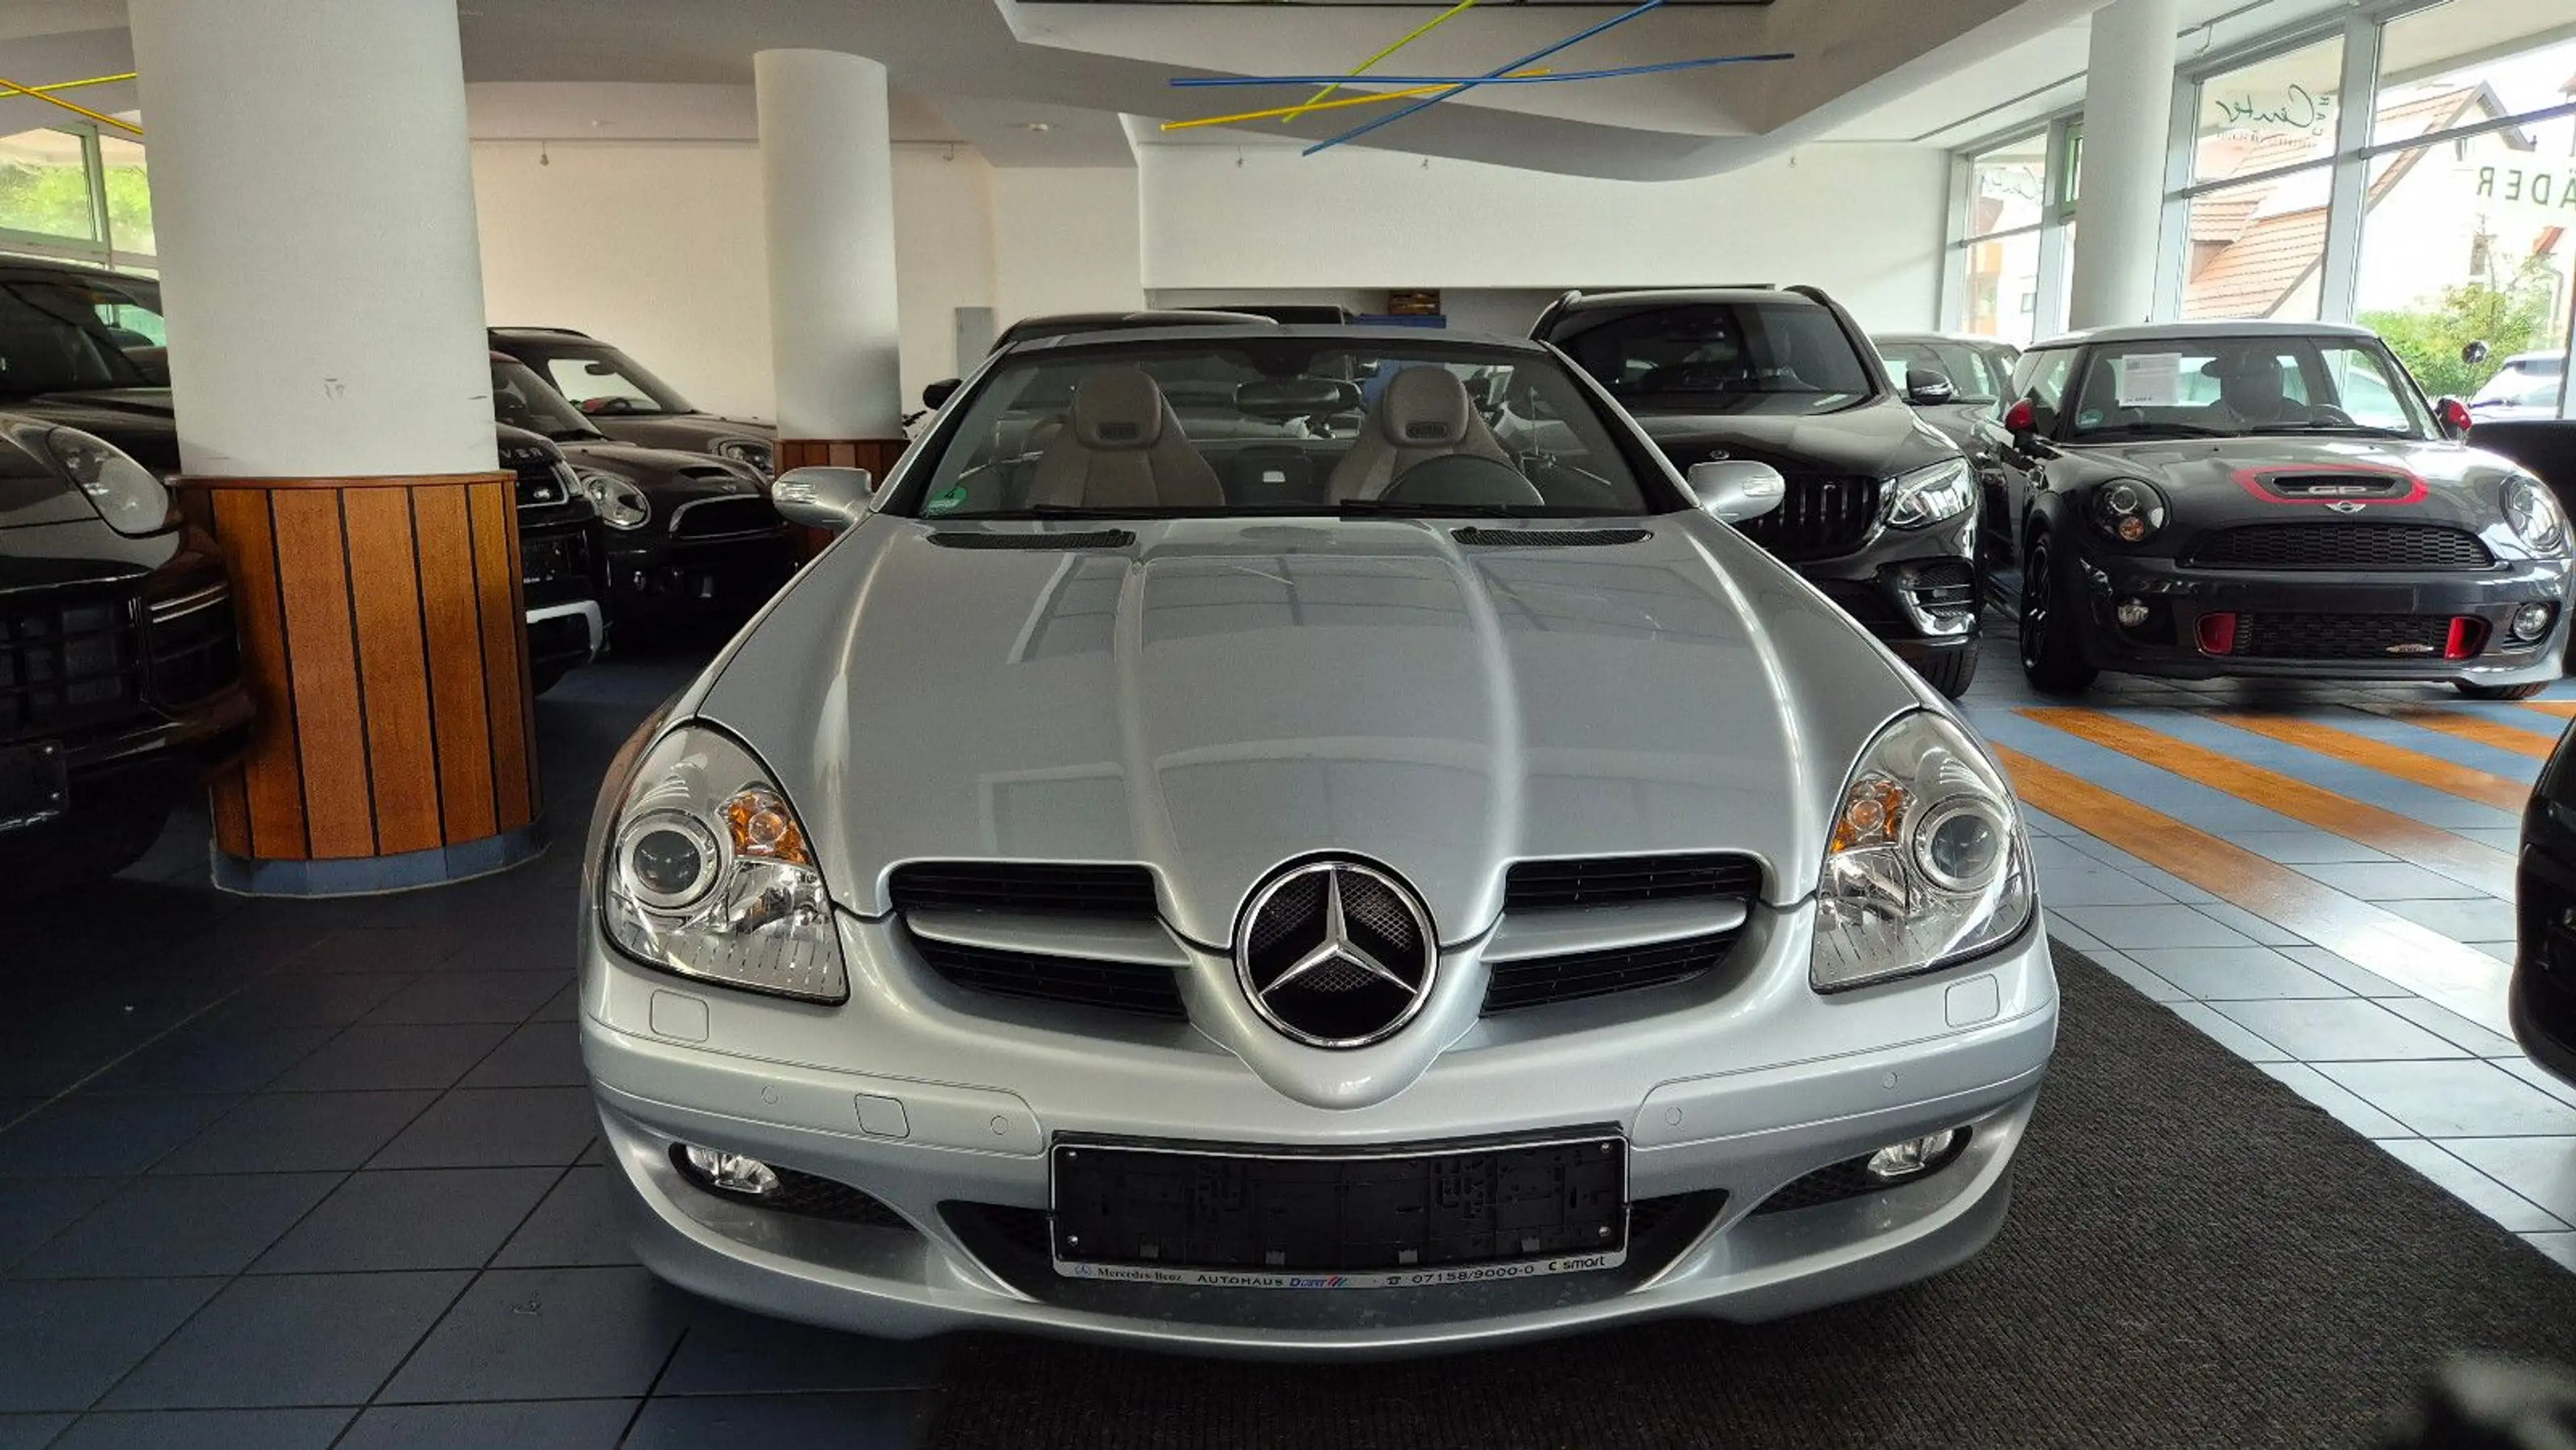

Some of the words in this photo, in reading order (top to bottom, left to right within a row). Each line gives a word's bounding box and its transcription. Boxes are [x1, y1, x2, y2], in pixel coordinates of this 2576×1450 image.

[499, 447, 543, 458] VER
[1563, 1255, 1605, 1270] smart
[1197, 1275, 1283, 1286] AUTOHAUS
